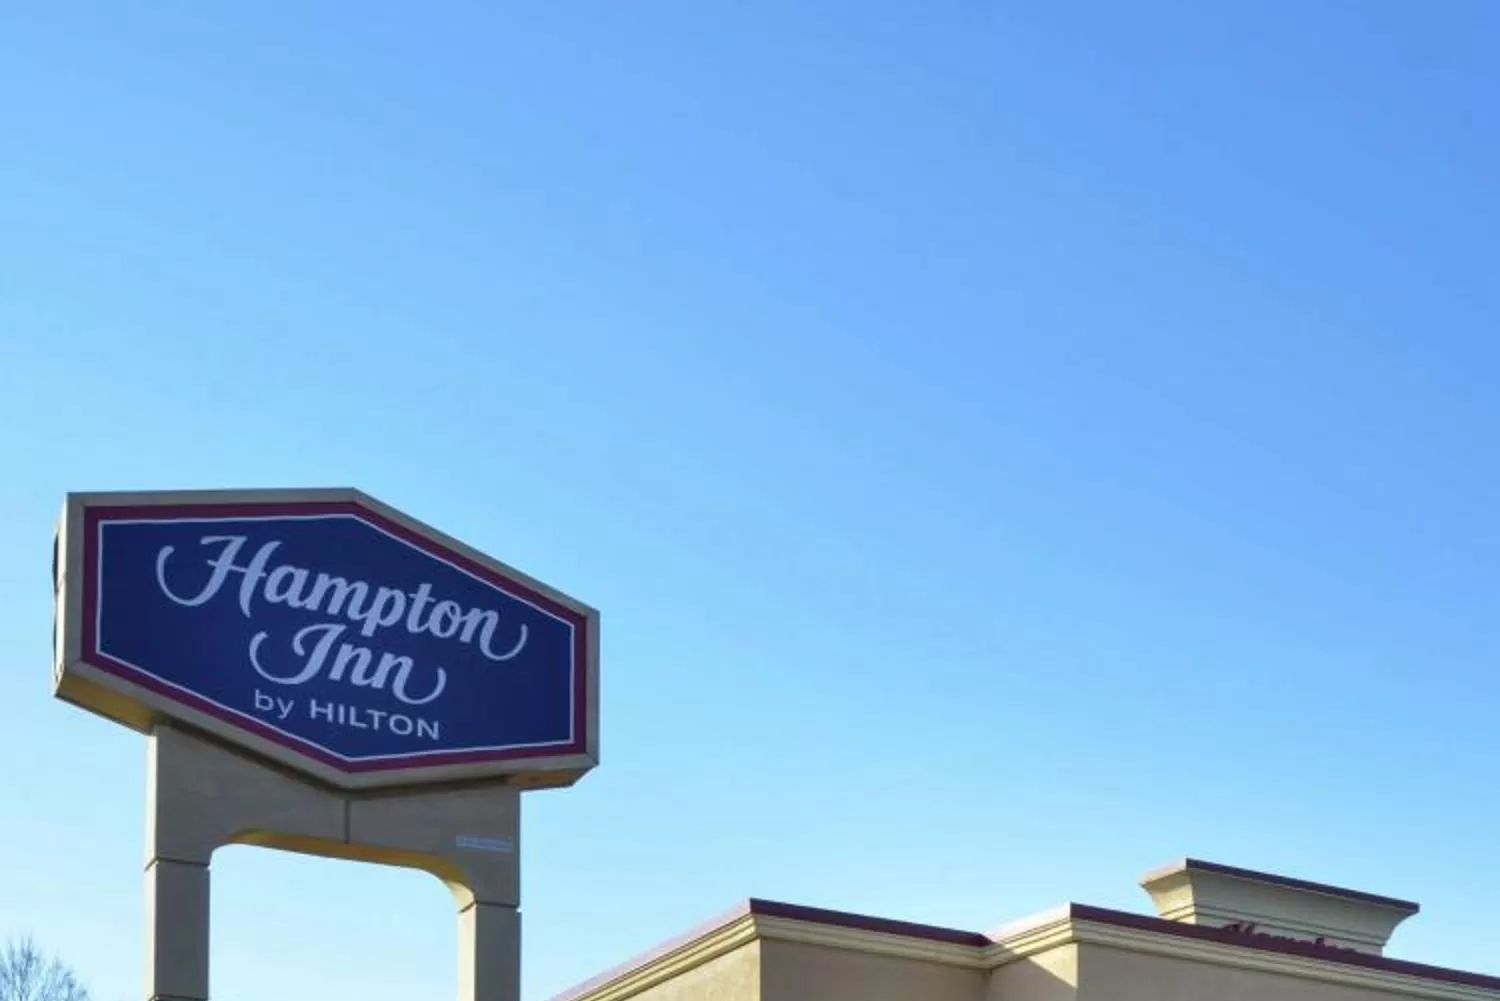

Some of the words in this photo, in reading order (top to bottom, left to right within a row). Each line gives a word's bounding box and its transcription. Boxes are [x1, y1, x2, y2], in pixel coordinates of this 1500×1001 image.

[156, 534, 528, 660] Hampton
[249, 622, 446, 705] Inn
[254, 689, 296, 720] by
[309, 699, 441, 741] HILTON
